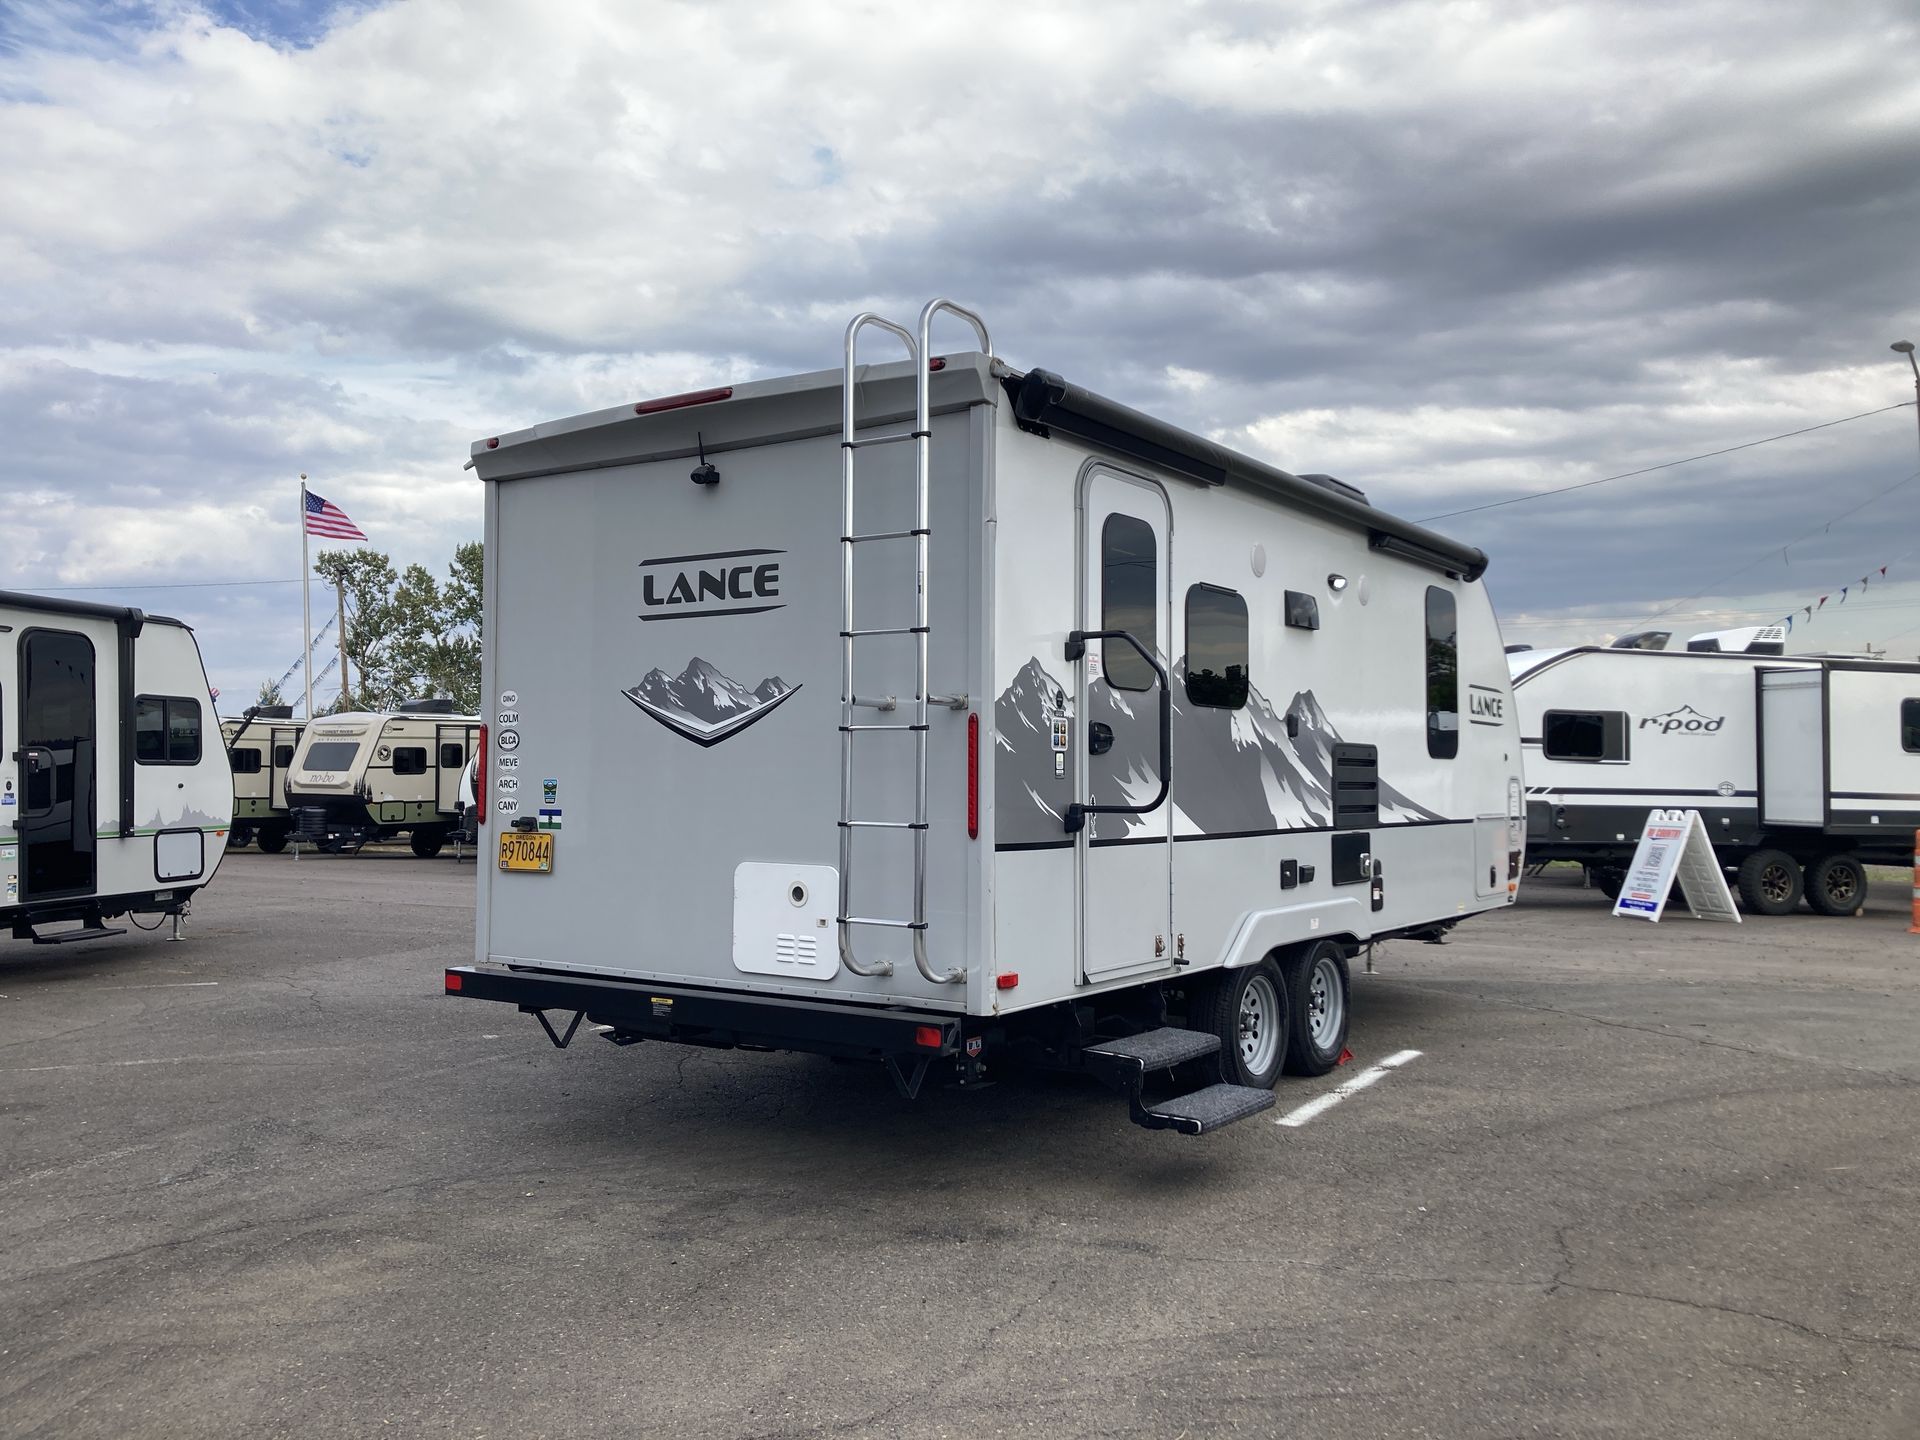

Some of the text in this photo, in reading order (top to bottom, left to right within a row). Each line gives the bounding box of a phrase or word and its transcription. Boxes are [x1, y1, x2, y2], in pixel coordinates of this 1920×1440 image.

[643, 563, 779, 606] LANCE
[1470, 694, 1503, 718] LANCE
[499, 714, 519, 723] COLM
[501, 736, 517, 745] BLCA
[499, 758, 518, 767] MEVE
[499, 779, 518, 789] ARCH
[498, 801, 518, 811] CANY
[501, 841, 549, 862] R970844
